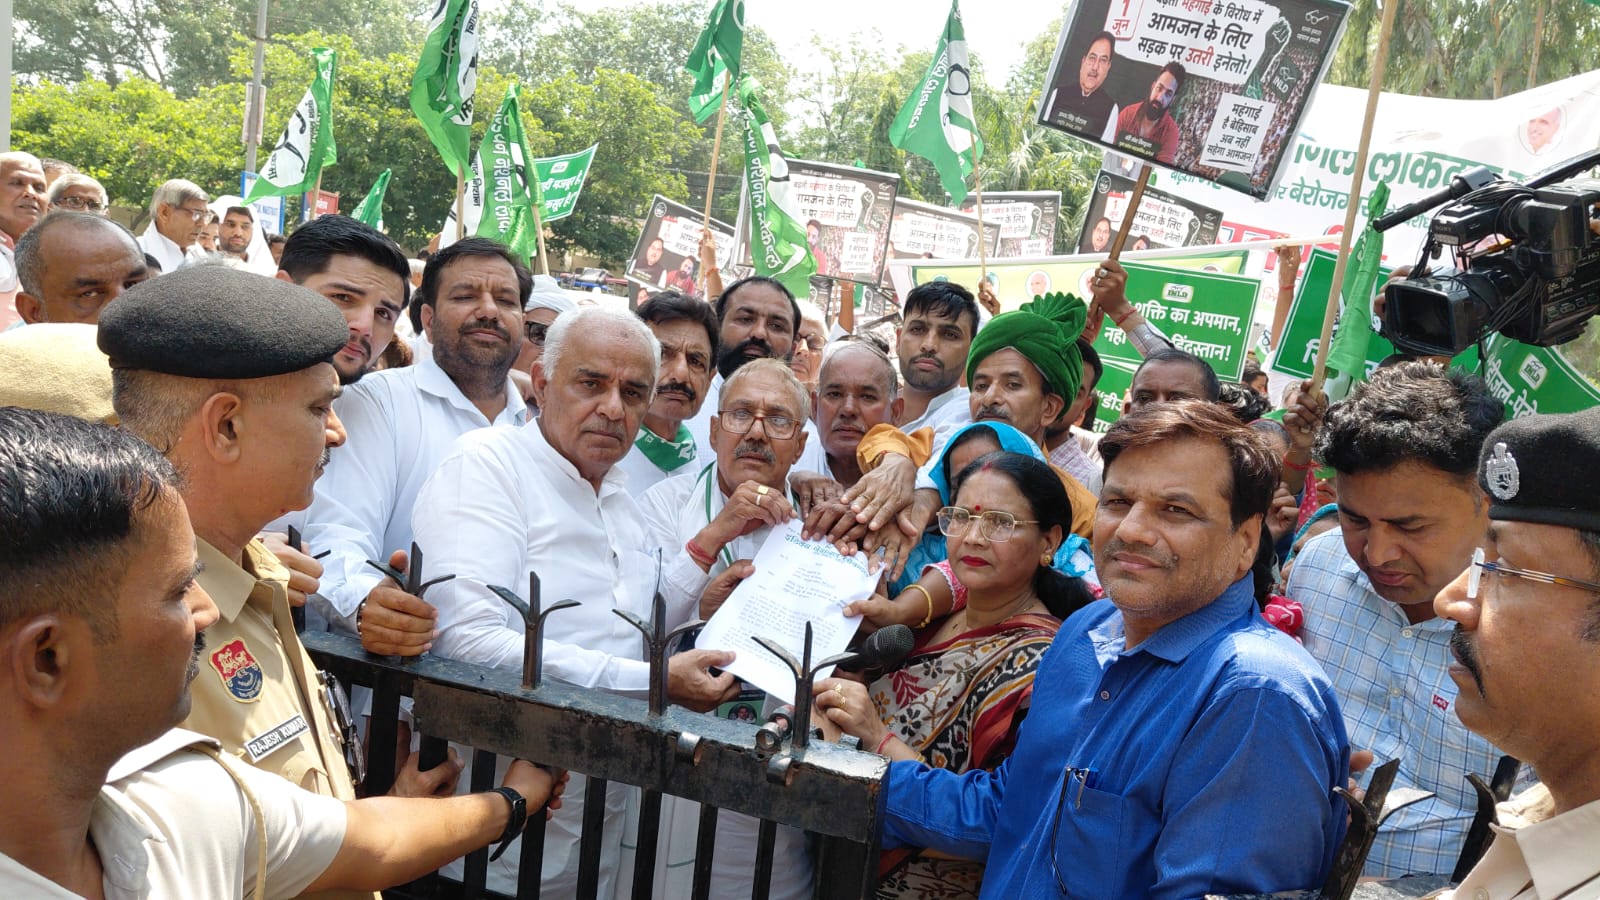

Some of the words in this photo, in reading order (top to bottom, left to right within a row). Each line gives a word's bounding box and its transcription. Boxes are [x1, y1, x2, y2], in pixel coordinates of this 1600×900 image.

[1213, 1, 1224, 16] के
[1224, 2, 1251, 23] विरोध
[1112, 19, 1130, 36] जून
[1148, 11, 1206, 39] आमजन
[1204, 19, 1221, 42] के
[1220, 22, 1254, 50] लिए
[1137, 36, 1169, 58] सड़क
[1169, 43, 1186, 61] पर
[1185, 45, 1215, 67] उतरी
[1213, 51, 1252, 76] इनेलो!
[1231, 103, 1264, 120] महंगाई
[1229, 118, 1260, 135] बेहिसाब
[1220, 134, 1235, 144] अब
[1234, 135, 1252, 149] नहीं
[1134, 209, 1158, 226] मजन
[1167, 288, 1189, 299] INLD
[1135, 299, 1169, 320] शक्ति
[1169, 306, 1190, 325] का
[1191, 310, 1242, 336] अपमान,
[249, 730, 282, 757] RAJESH
[280, 717, 308, 740] KUMAR
